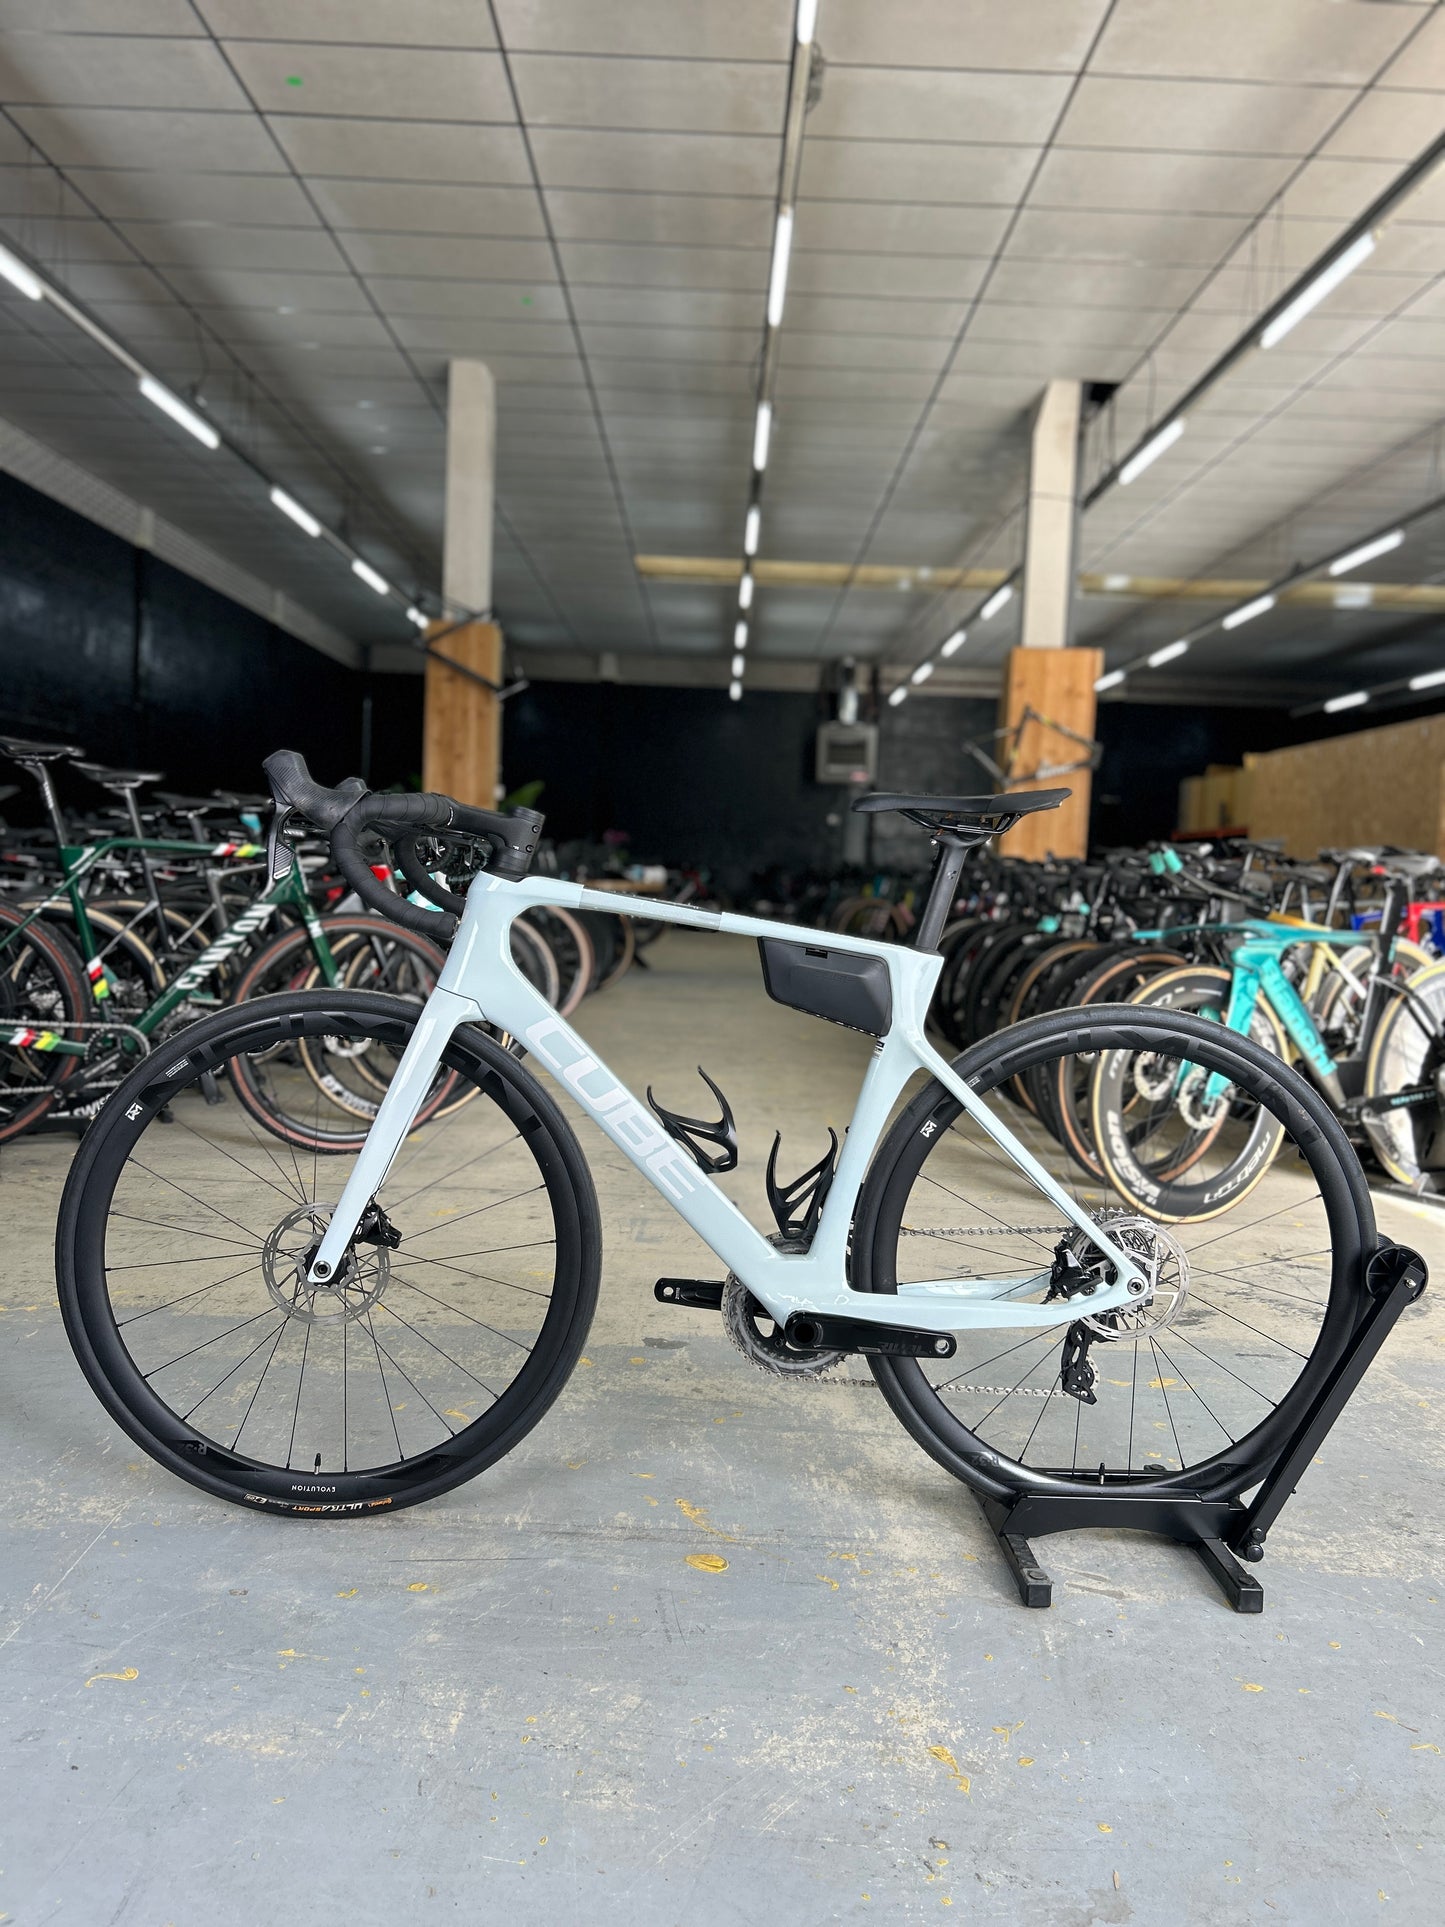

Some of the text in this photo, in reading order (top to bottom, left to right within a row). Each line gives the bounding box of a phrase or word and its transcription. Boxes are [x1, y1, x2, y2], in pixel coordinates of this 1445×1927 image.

[175, 904, 277, 990] CANYON
[525, 1016, 706, 1200] CUBE
[291, 1484, 336, 1493] EVOLUTION
